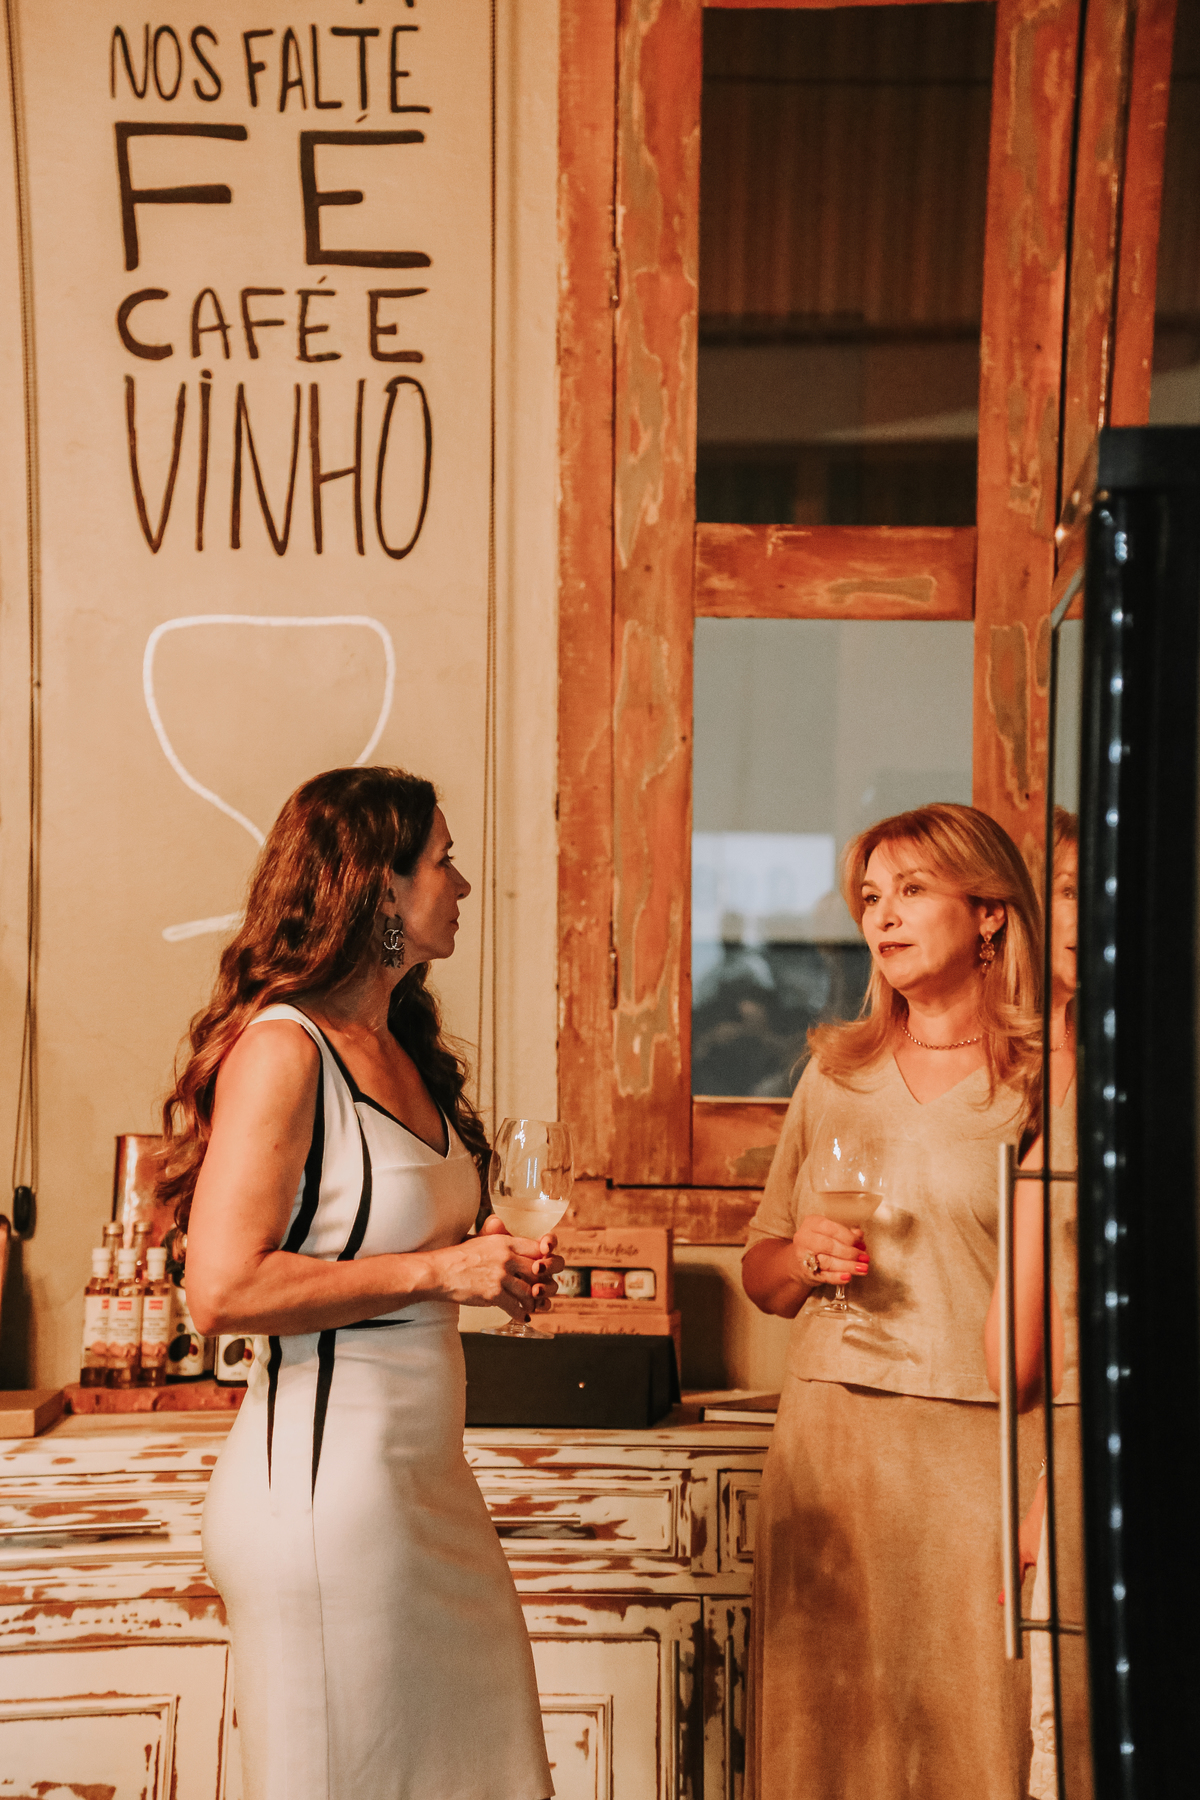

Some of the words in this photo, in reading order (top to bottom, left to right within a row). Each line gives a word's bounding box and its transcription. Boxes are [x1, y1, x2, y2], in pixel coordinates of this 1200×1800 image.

[110, 23, 223, 102] NOS
[242, 23, 432, 114] FALTE
[114, 113, 433, 272] FÉ
[116, 276, 342, 364] CAFÉ
[367, 287, 429, 364] E
